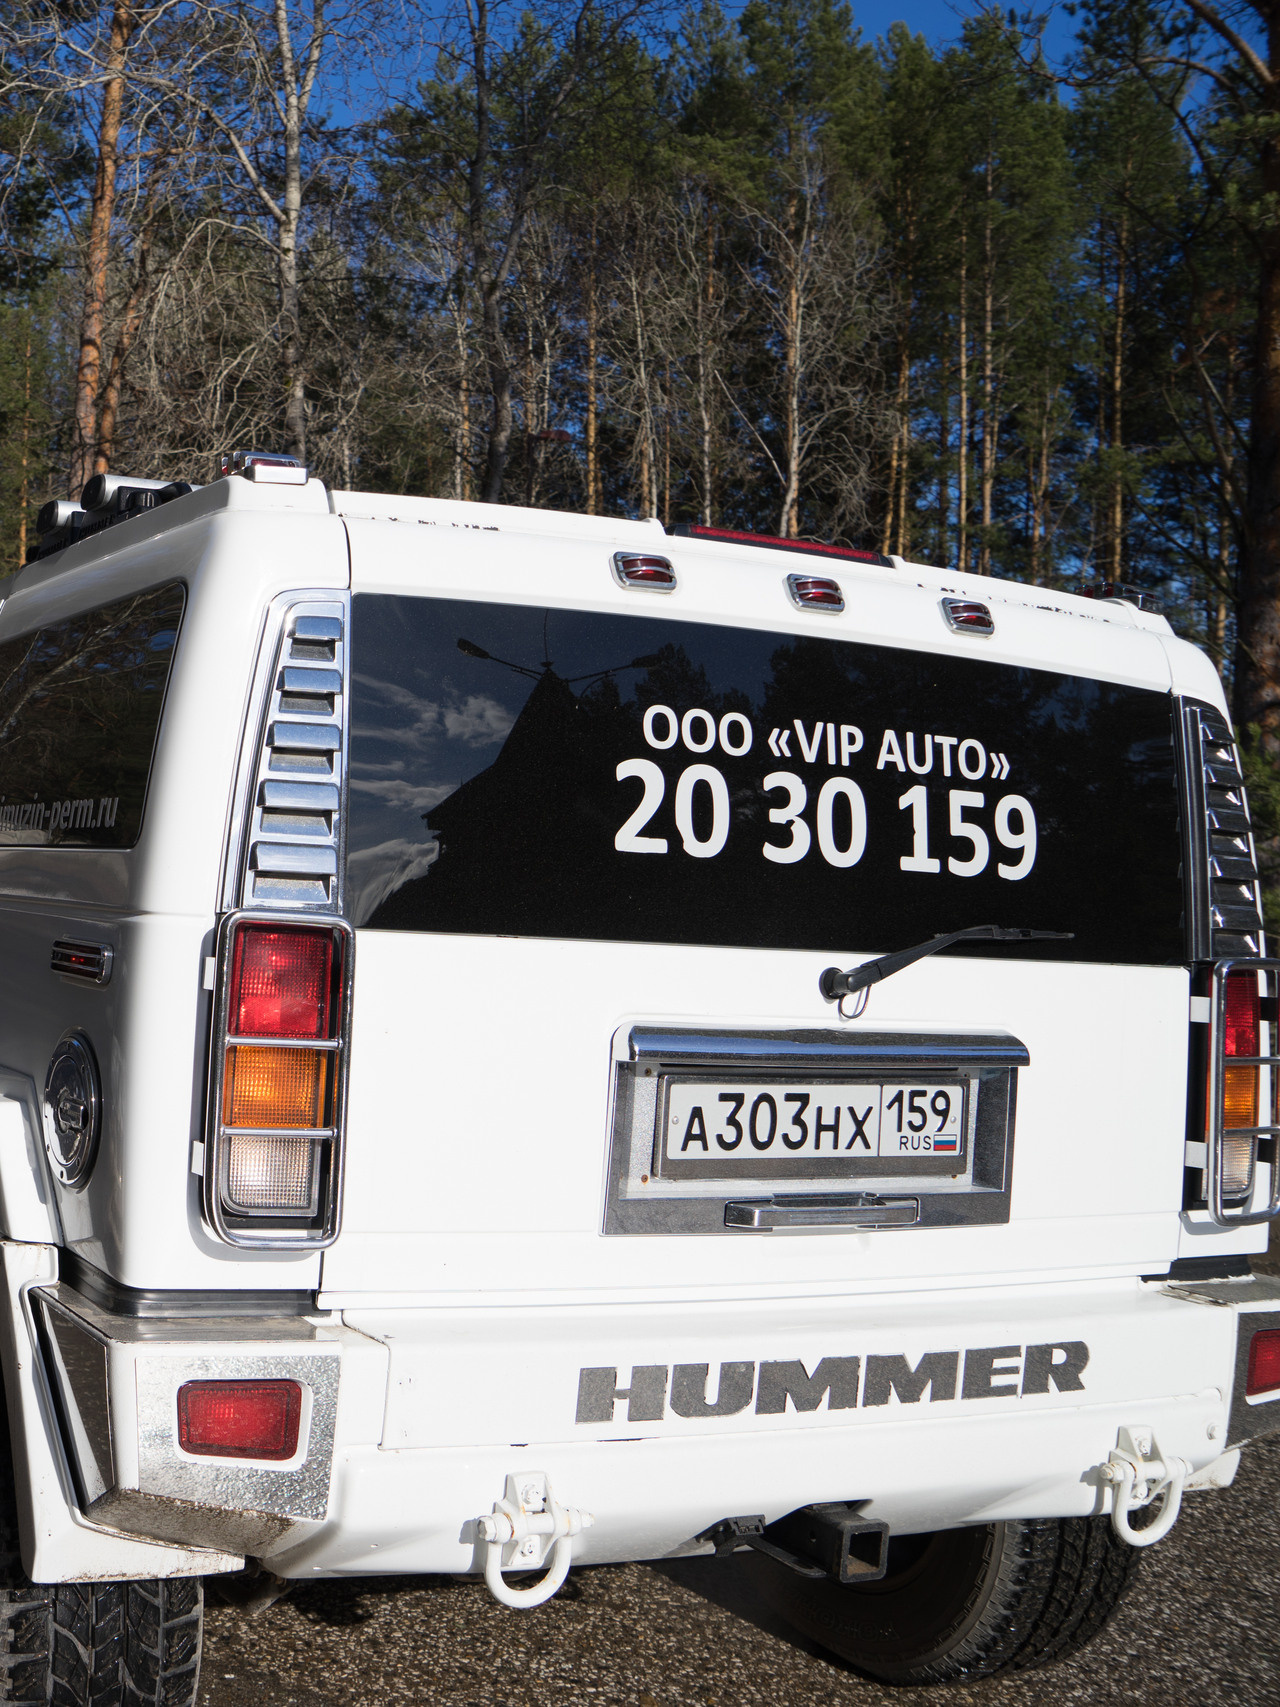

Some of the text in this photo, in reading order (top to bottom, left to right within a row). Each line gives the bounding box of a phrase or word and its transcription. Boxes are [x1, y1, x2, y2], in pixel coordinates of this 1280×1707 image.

[767, 719, 864, 767] «VIP
[876, 729, 1010, 780] AUTO»
[614, 758, 1037, 881] 20 30 159
[885, 1089, 951, 1133] 159
[899, 1135, 932, 1151] RUS
[575, 1341, 1090, 1424] HUMMER
